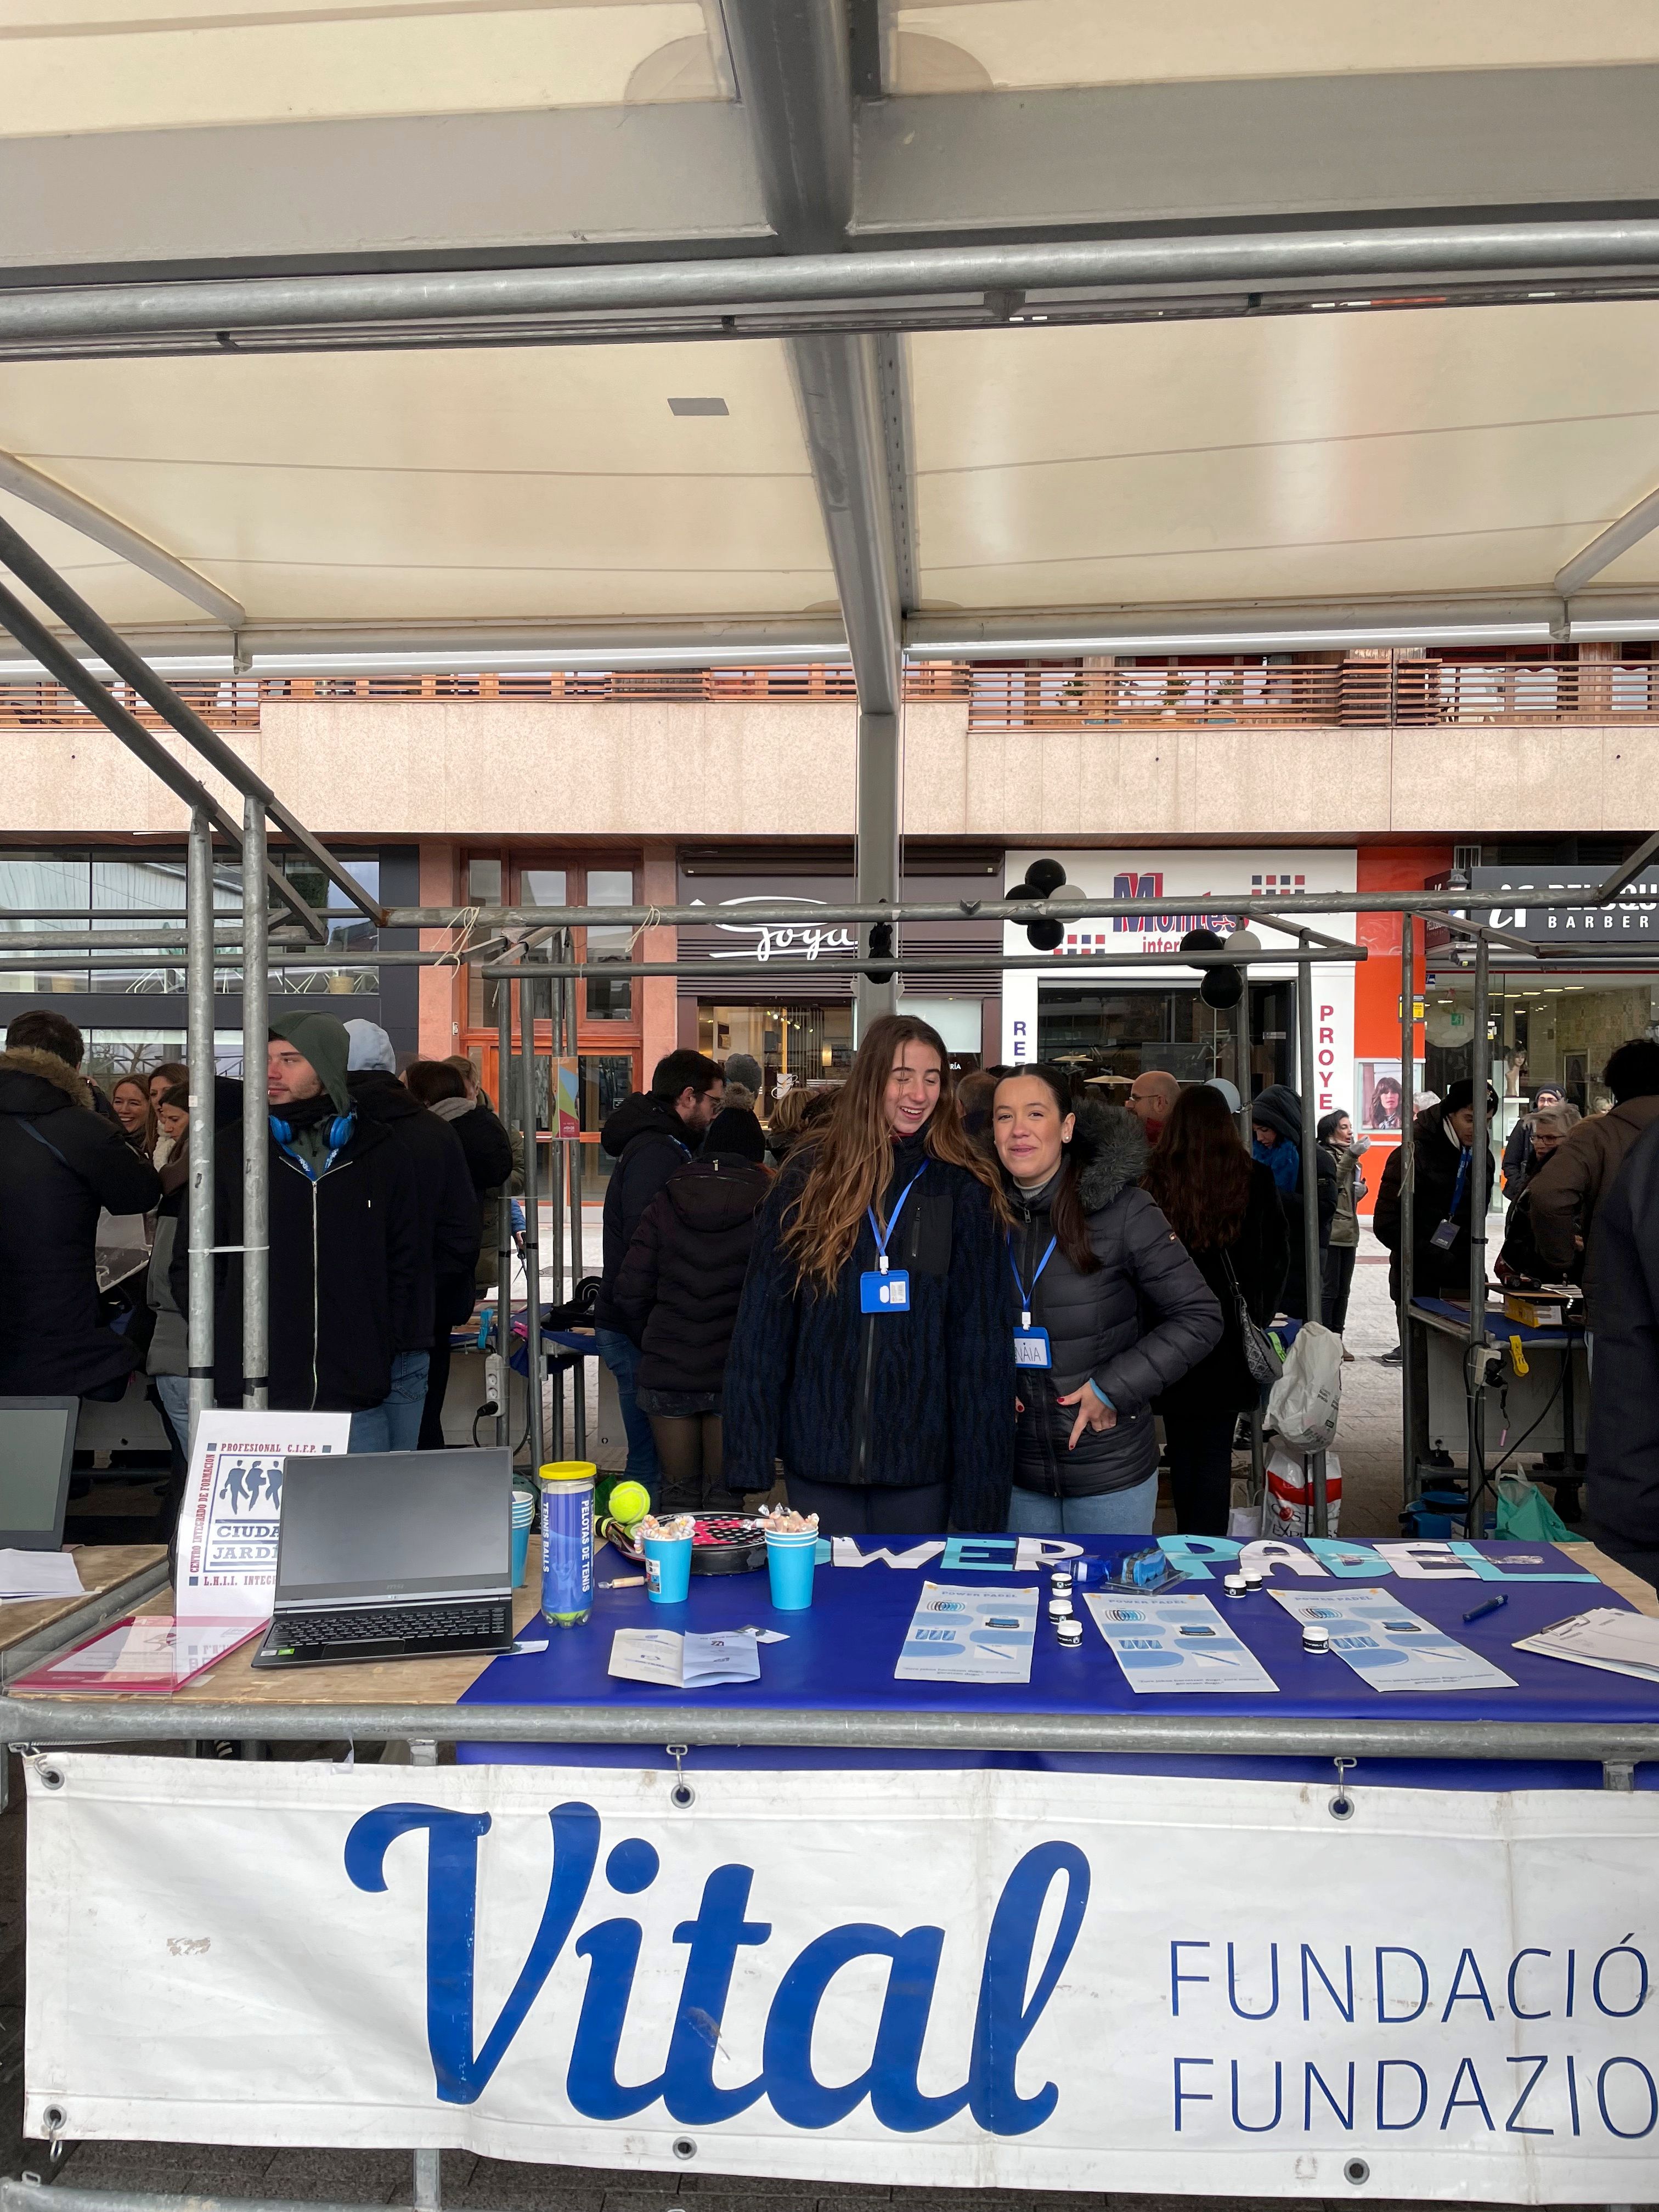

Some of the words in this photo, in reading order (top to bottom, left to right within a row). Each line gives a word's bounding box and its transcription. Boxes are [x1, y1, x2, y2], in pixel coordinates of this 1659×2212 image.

[1548, 915, 1649, 928] BARBER
[1014, 1021, 1026, 1066] RE
[221, 1443, 281, 1452] PROFESIONAL
[287, 1444, 317, 1453] C.I.F.P.
[200, 1454, 215, 1491] FORMACION
[198, 1493, 208, 1502] DE
[192, 1504, 207, 1543] INTEGRADO
[217, 1526, 280, 1537] CIUDA
[581, 1500, 590, 1545] PELOTAS
[190, 1545, 201, 1572] CENTRO
[582, 1546, 590, 1561] DE
[244, 1575, 276, 1585] INTEG
[582, 1561, 590, 1593] TENIS
[344, 1802, 1091, 2137] Vital
[1170, 1932, 1648, 2023] FUNDACIÓ
[1173, 2055, 1658, 2140] FUNDAZIO
